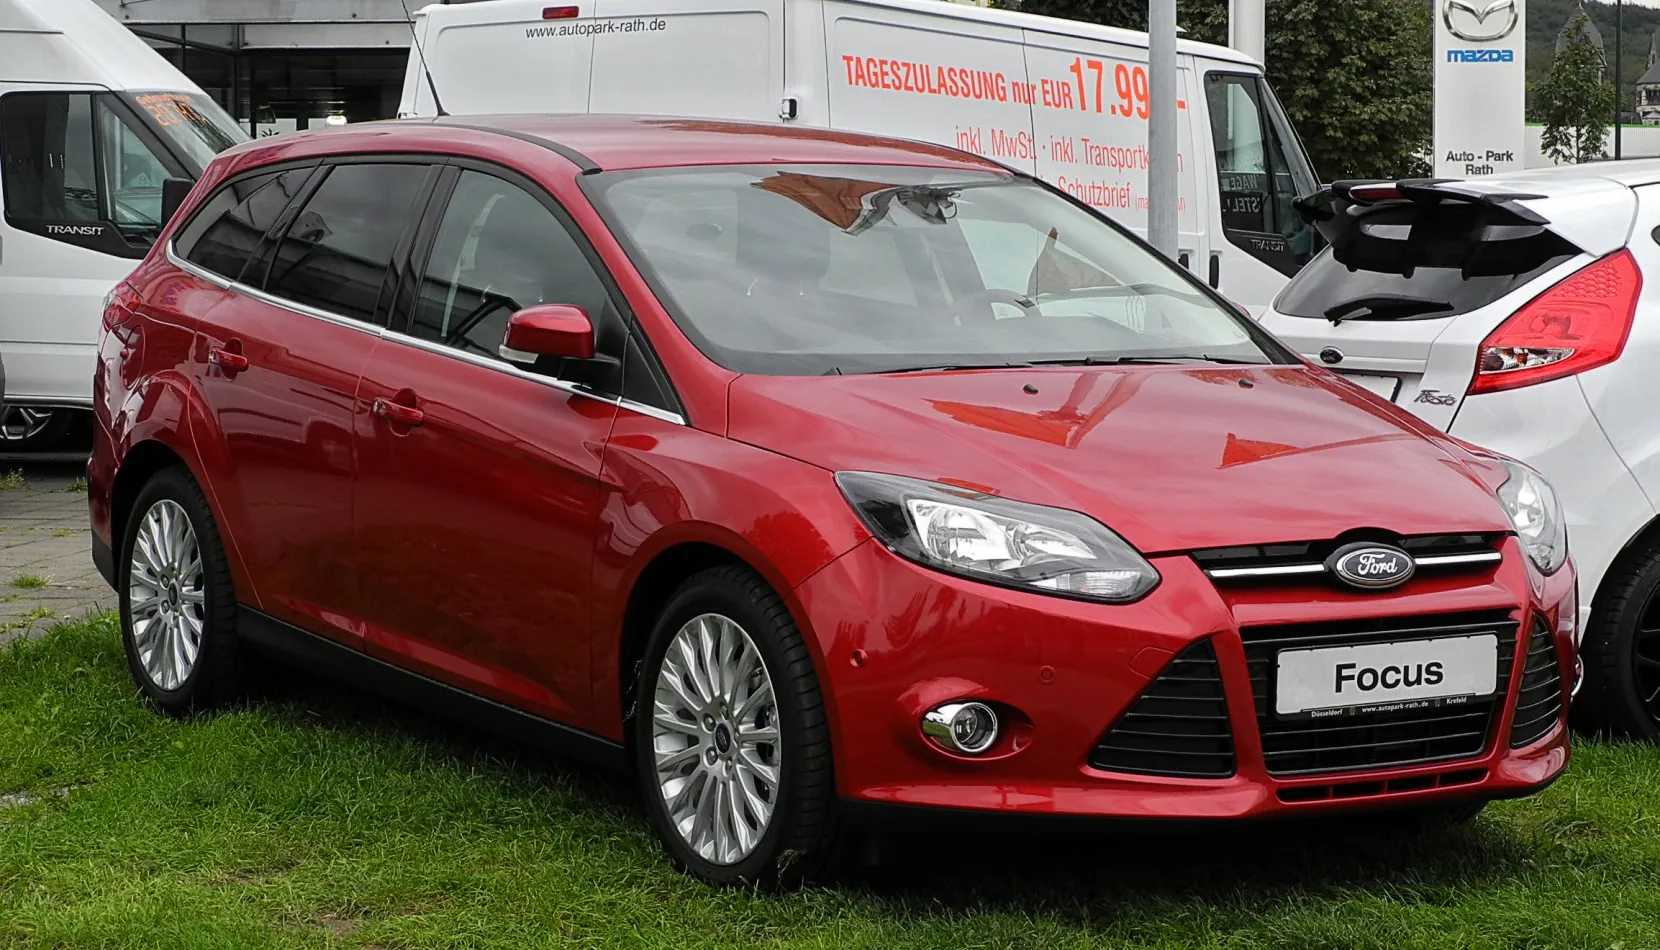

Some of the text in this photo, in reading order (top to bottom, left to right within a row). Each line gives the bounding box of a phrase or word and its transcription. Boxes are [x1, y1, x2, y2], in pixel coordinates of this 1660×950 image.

[525, 18, 666, 38] www.autopark-rath.de
[1446, 49, 1514, 63] mazda
[842, 54, 1007, 103] TAGESZULASSUNG
[1011, 80, 1037, 105] nur
[1040, 78, 1074, 110] EUR
[955, 125, 986, 156] inkl.
[990, 128, 1037, 160] MwSt.
[1050, 134, 1078, 165] inkl.
[1446, 150, 1475, 162] Auto
[1485, 150, 1514, 162] Park
[1465, 164, 1494, 176] Rath
[1058, 175, 1131, 209] Schutzbrief
[45, 224, 104, 236] TRANSIT
[1250, 239, 1285, 252] TRANSIT
[1357, 552, 1398, 576] Ford
[1334, 660, 1444, 694] Focus
[1311, 696, 1467, 718] Düsseldorf www.autopark-rath.de Krefeld
